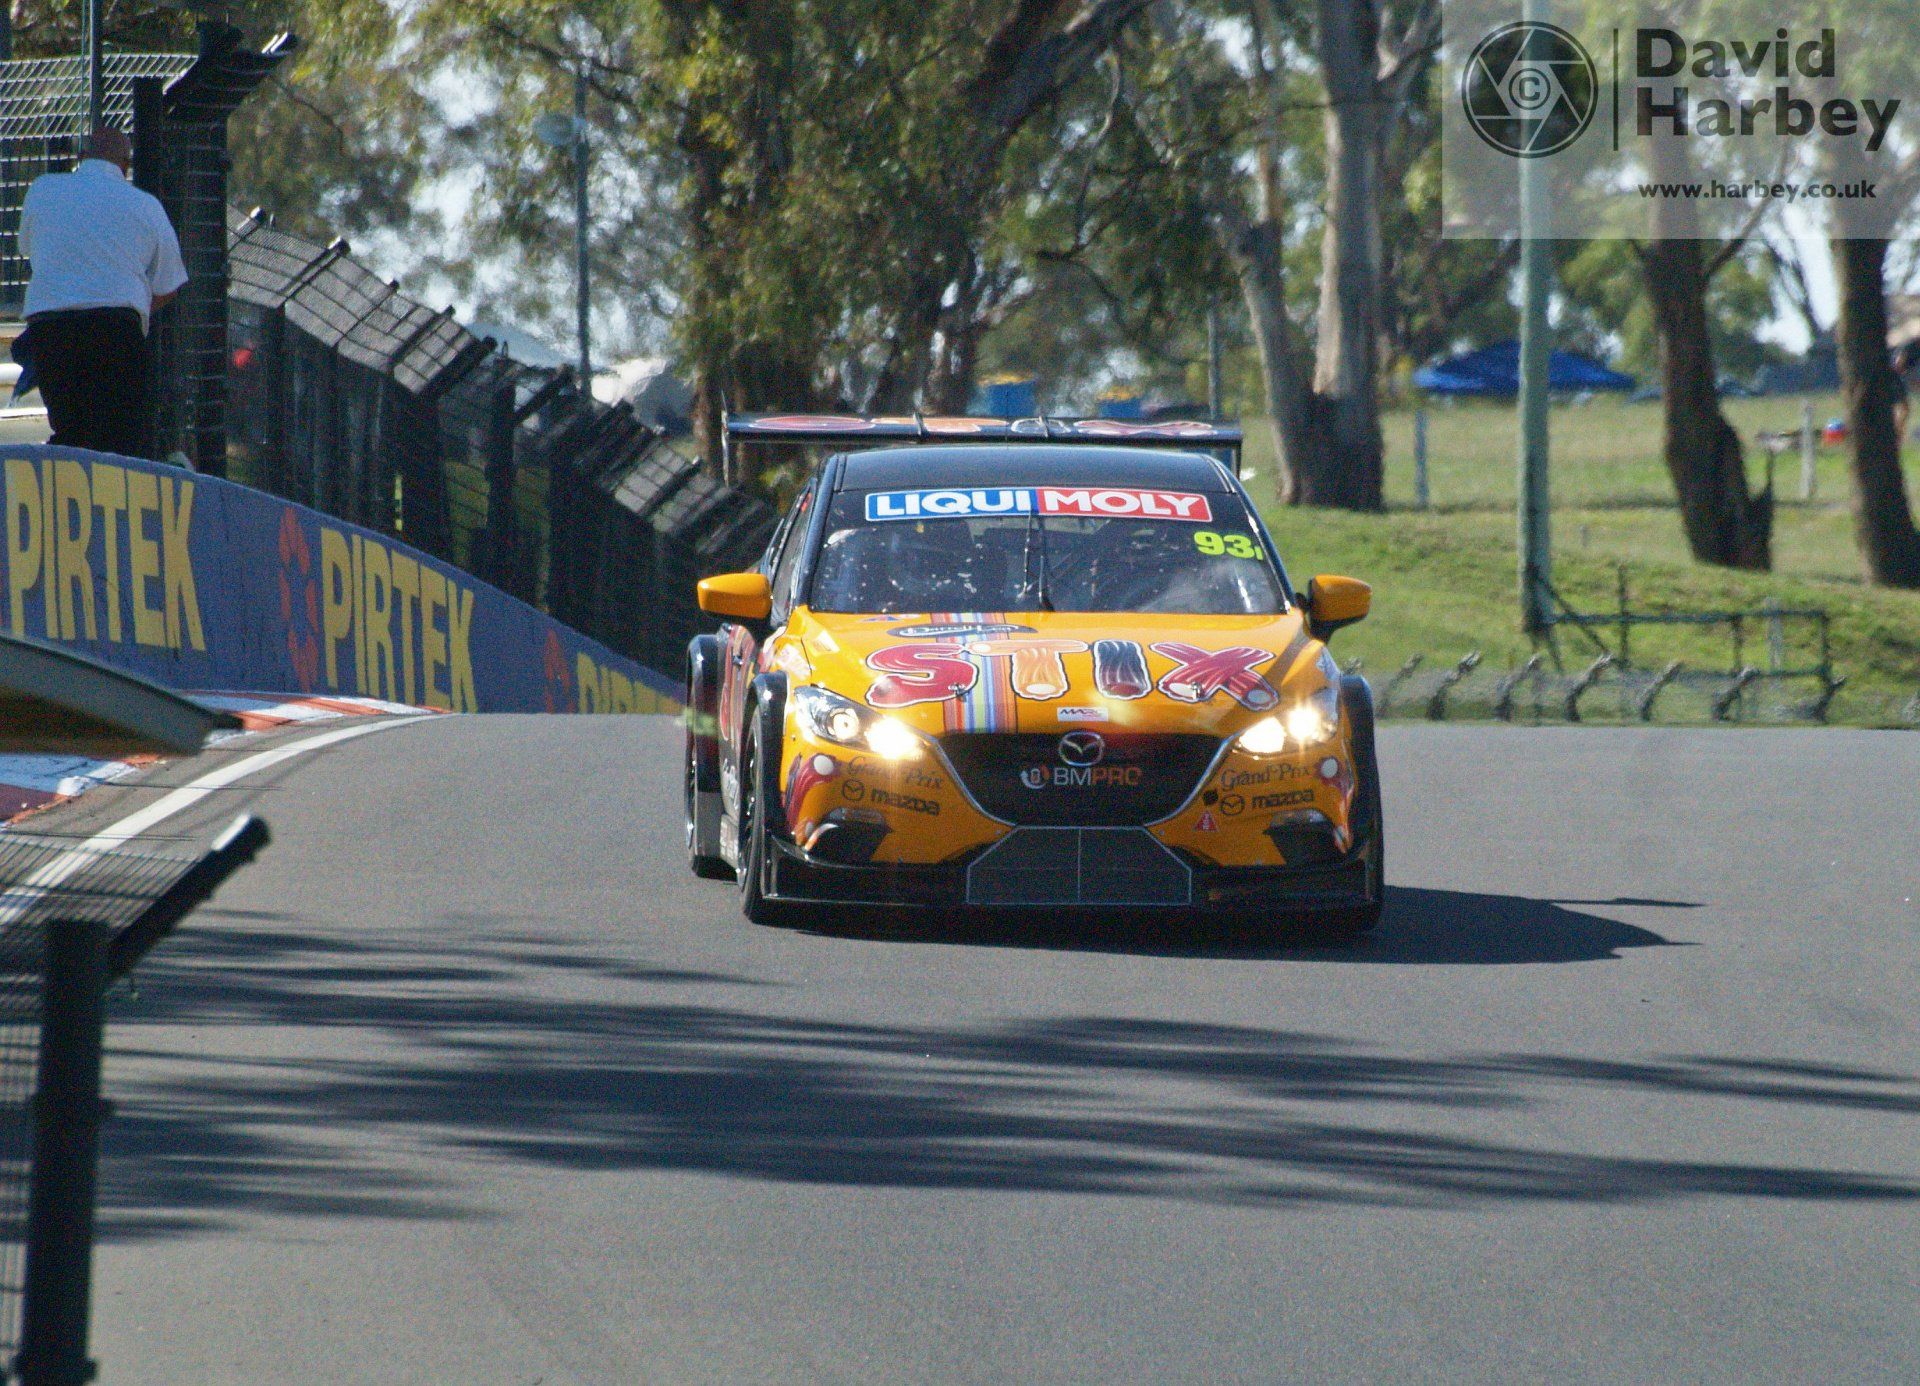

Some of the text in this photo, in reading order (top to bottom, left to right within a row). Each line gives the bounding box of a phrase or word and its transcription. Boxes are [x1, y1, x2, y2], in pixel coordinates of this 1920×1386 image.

[876, 489, 1201, 517] LIQUI MOLY
[4, 458, 206, 652] PIRTEK
[320, 527, 478, 714] PIRTEK
[866, 639, 1279, 711] STIX
[1053, 767, 1142, 786] BMPRO
